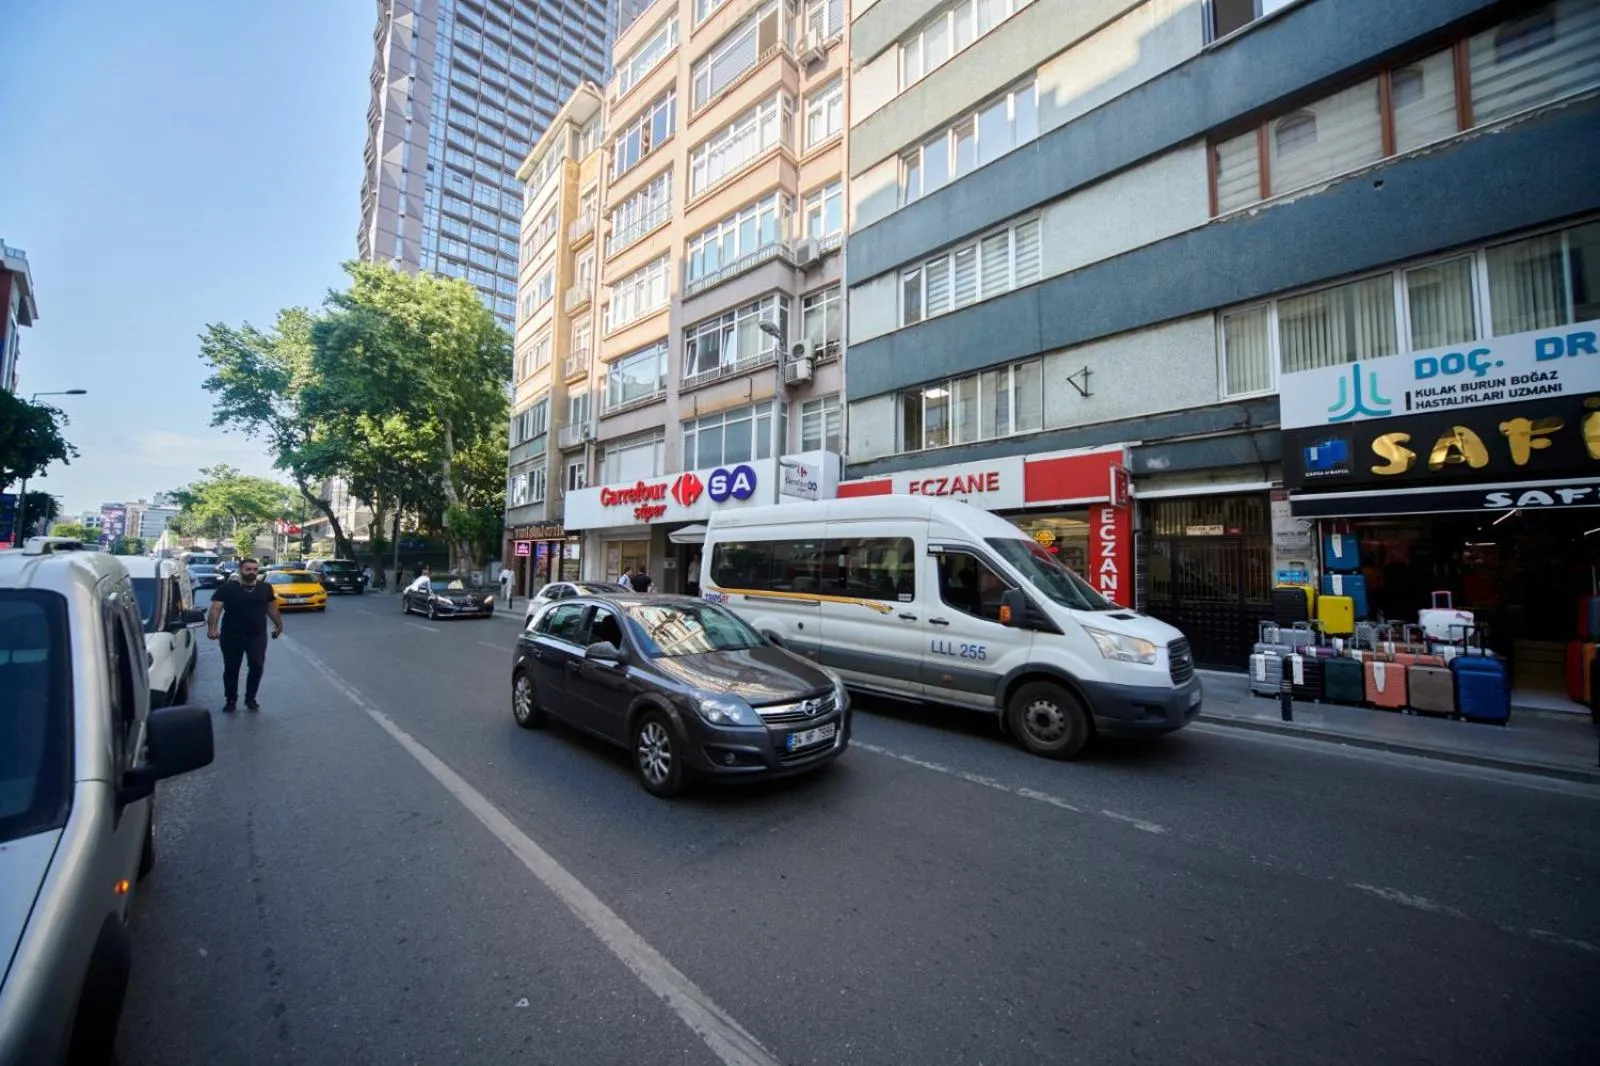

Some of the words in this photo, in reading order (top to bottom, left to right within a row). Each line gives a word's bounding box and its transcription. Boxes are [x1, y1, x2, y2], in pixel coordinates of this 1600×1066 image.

[1414, 348, 1504, 380] DOÇ.
[1415, 384, 1457, 398] KULAK
[1460, 378, 1506, 392] BURUN
[1510, 370, 1559, 386] BOĞAZ
[1415, 391, 1504, 410] HASTALIKLARI
[1508, 383, 1562, 398] UZMANI
[601, 481, 668, 507] Carrefour
[710, 471, 752, 496] SA
[909, 472, 1000, 496] ECZANE
[634, 503, 668, 523] süper
[1100, 508, 1118, 601] ECZANE
[931, 640, 956, 656] LLL
[960, 643, 987, 661] 255
